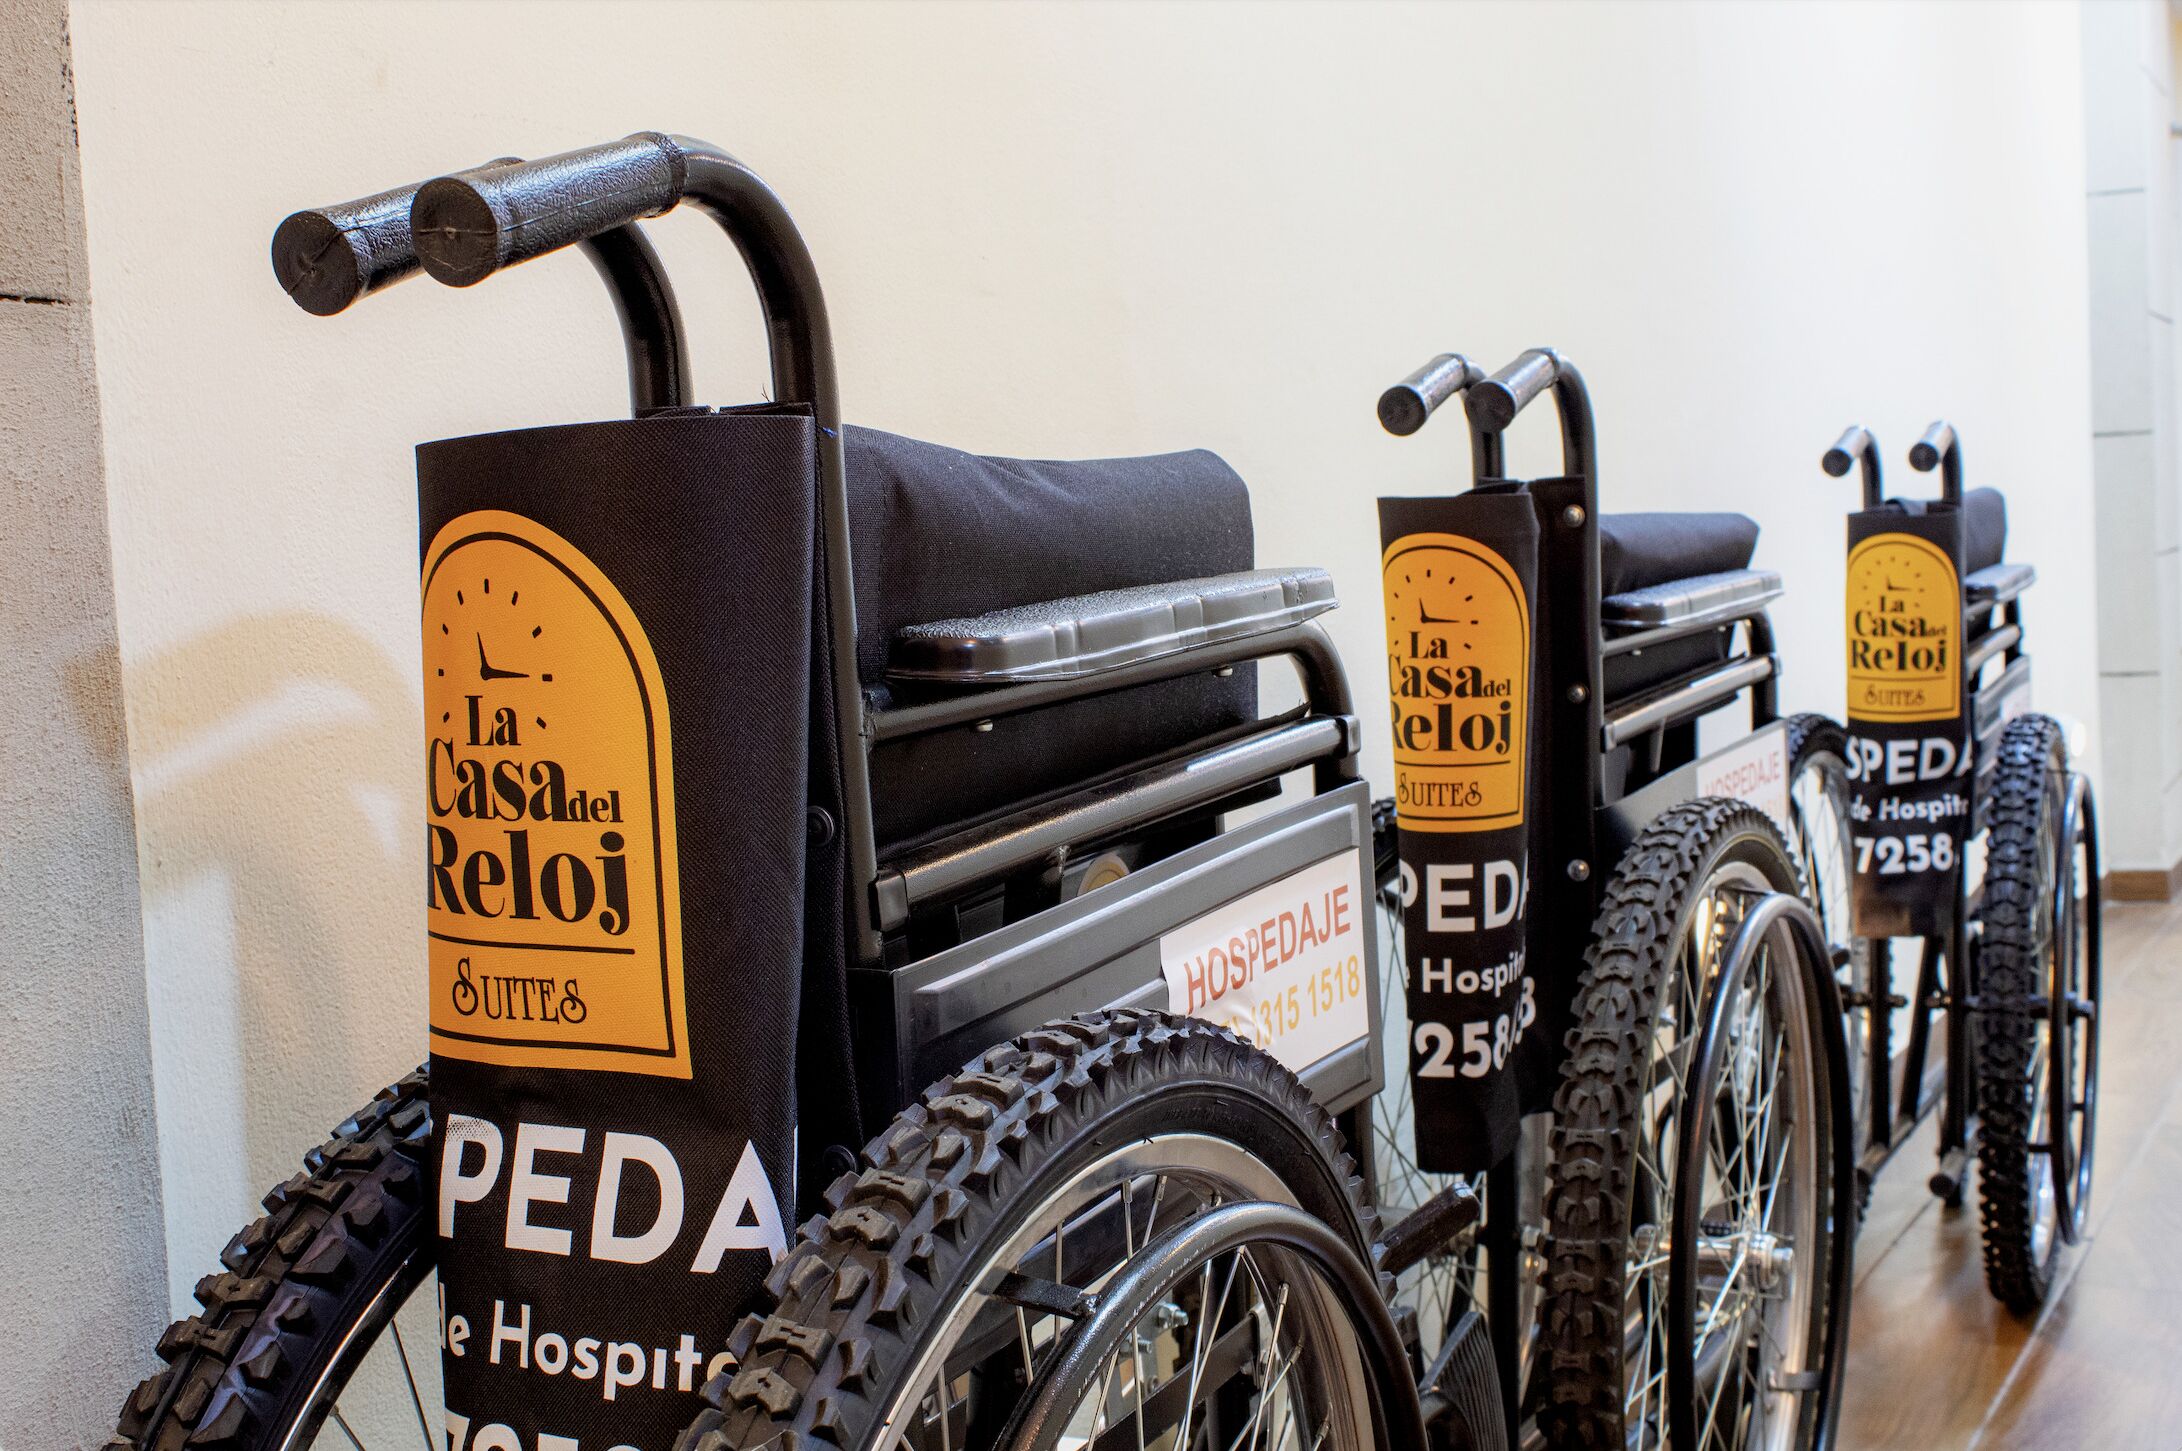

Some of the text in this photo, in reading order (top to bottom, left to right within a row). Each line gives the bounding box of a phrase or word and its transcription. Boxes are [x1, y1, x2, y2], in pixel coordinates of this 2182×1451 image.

[1855, 610, 1926, 637] Casa
[1879, 596, 1904, 612] La
[1409, 630, 1448, 659] La
[1852, 639, 1947, 672] Reloj
[1389, 653, 1511, 699] Casa del
[464, 695, 521, 746] La
[430, 737, 624, 823] Casa del
[1399, 772, 1482, 808] SUITES
[427, 822, 631, 936] Reloj
[1184, 884, 1351, 1016] HOSPEDAJE
[452, 956, 587, 1025] SUITES
[1307, 954, 1361, 1019] 1518
